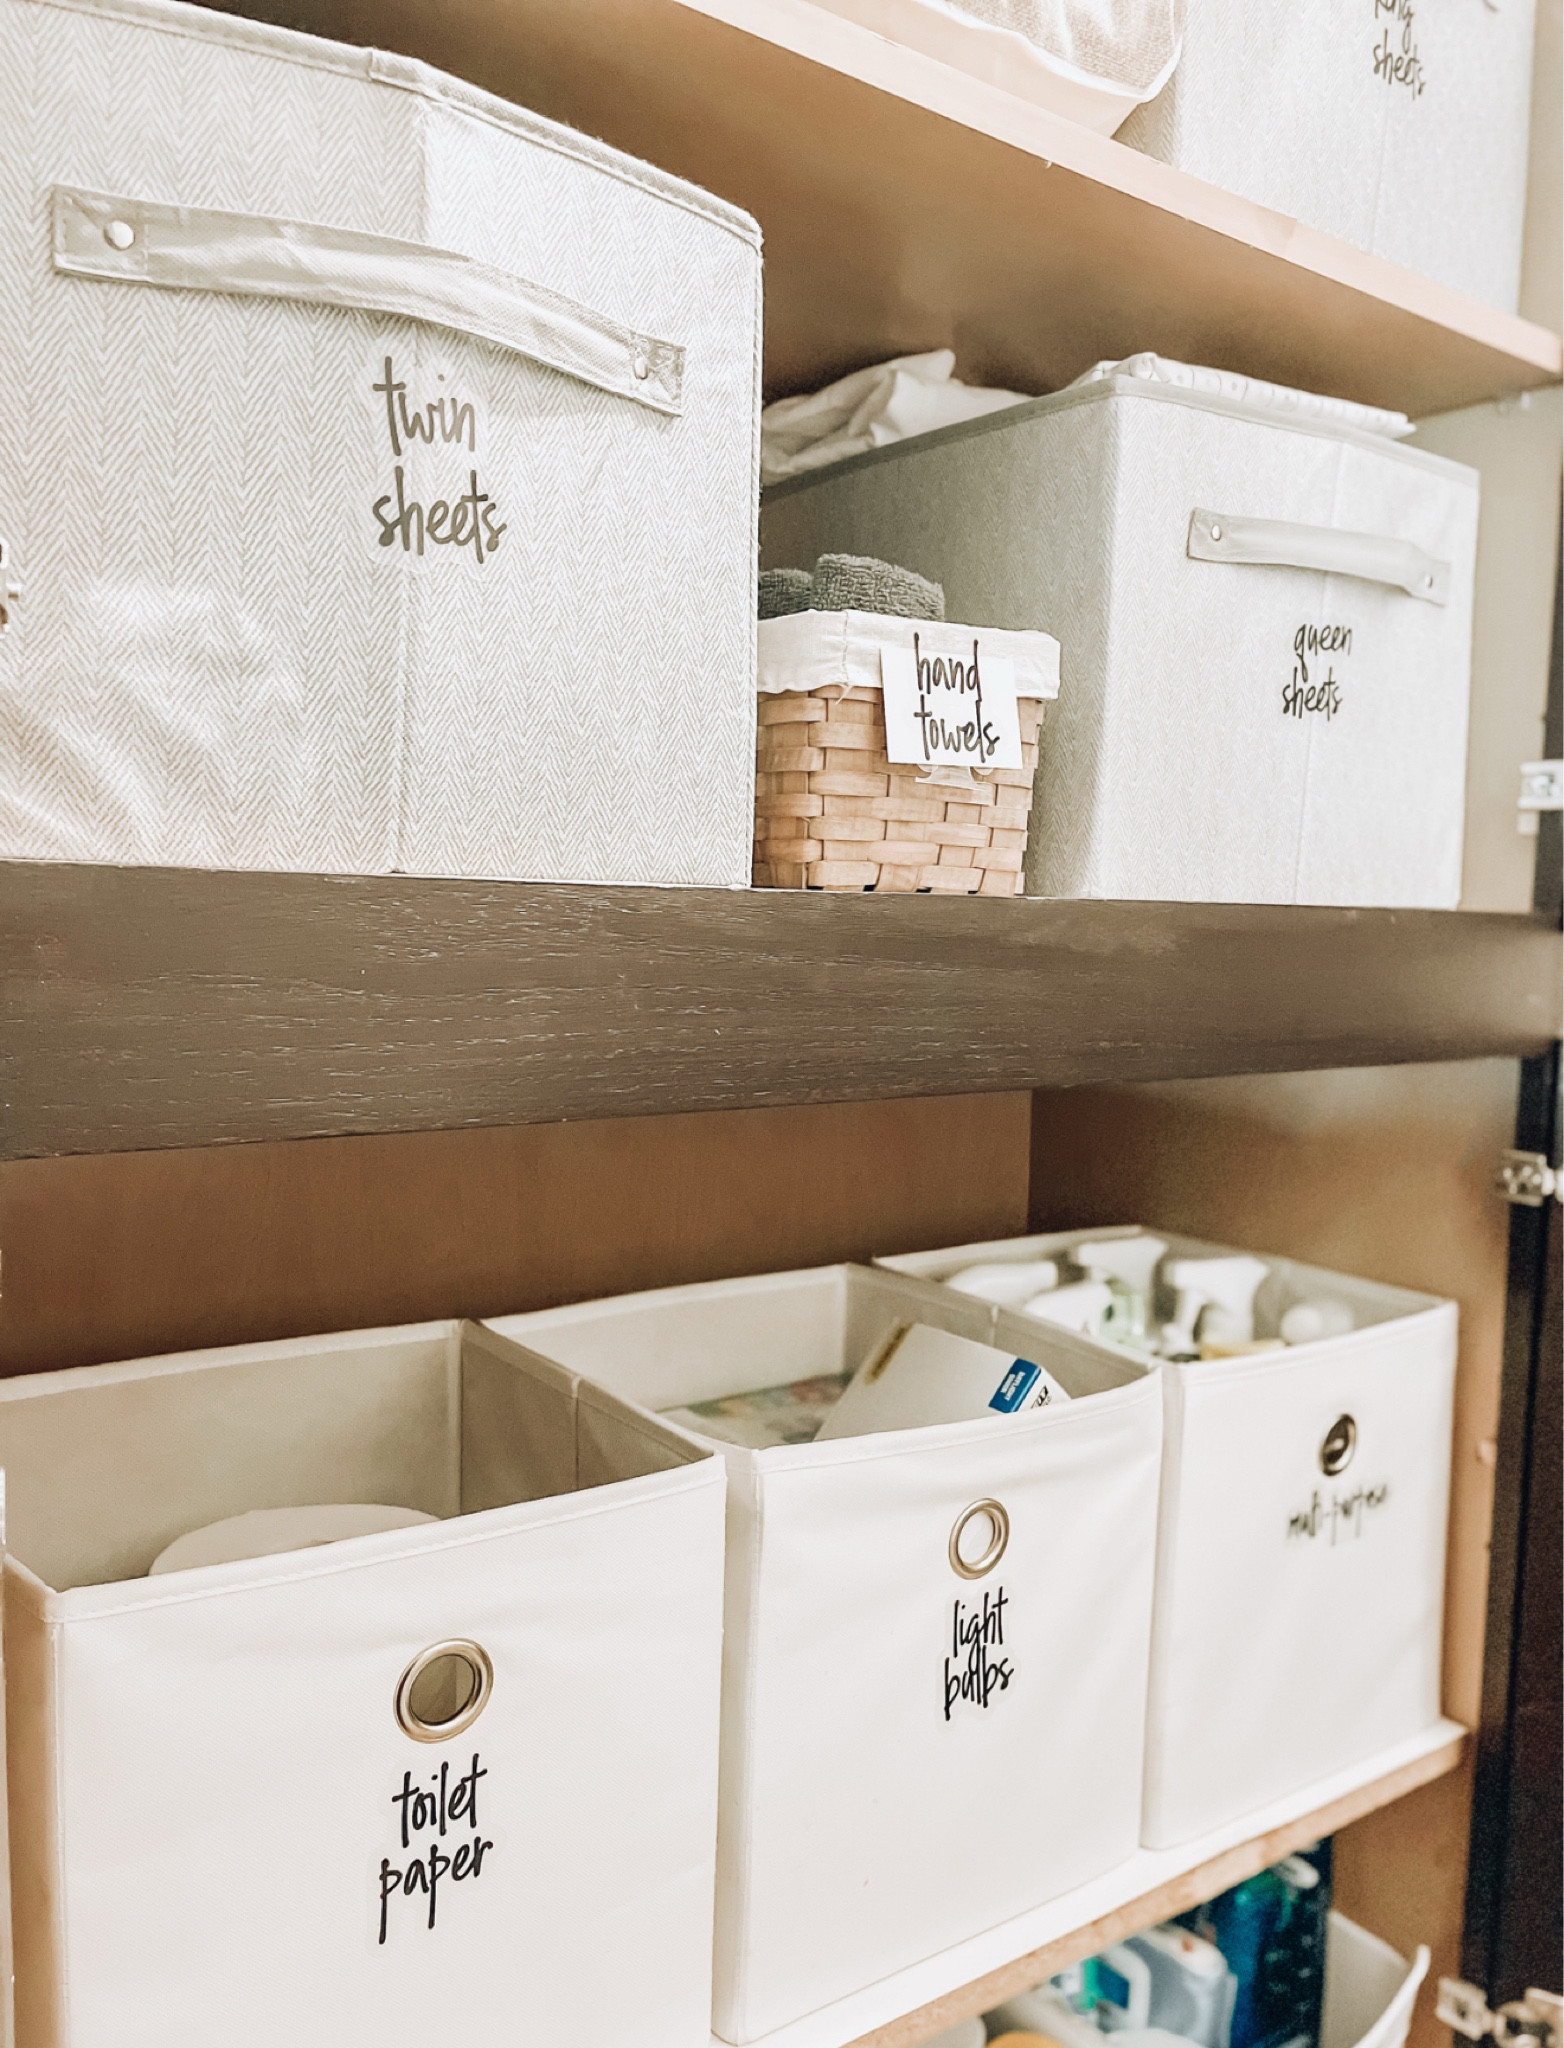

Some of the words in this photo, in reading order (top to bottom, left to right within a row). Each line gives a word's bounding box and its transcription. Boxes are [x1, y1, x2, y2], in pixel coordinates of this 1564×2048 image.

[1373, 28, 1426, 101] sheets
[372, 356, 475, 456] twin
[372, 465, 507, 564] sheets
[913, 632, 982, 701] hand
[1294, 624, 1352, 683] queen
[913, 694, 1000, 763] towels
[1282, 666, 1343, 722] sheets
[953, 1586, 1009, 1674] light
[944, 1644, 1014, 1721] bulbs
[391, 1753, 488, 1848] toilet
[379, 1836, 493, 1944] paper
